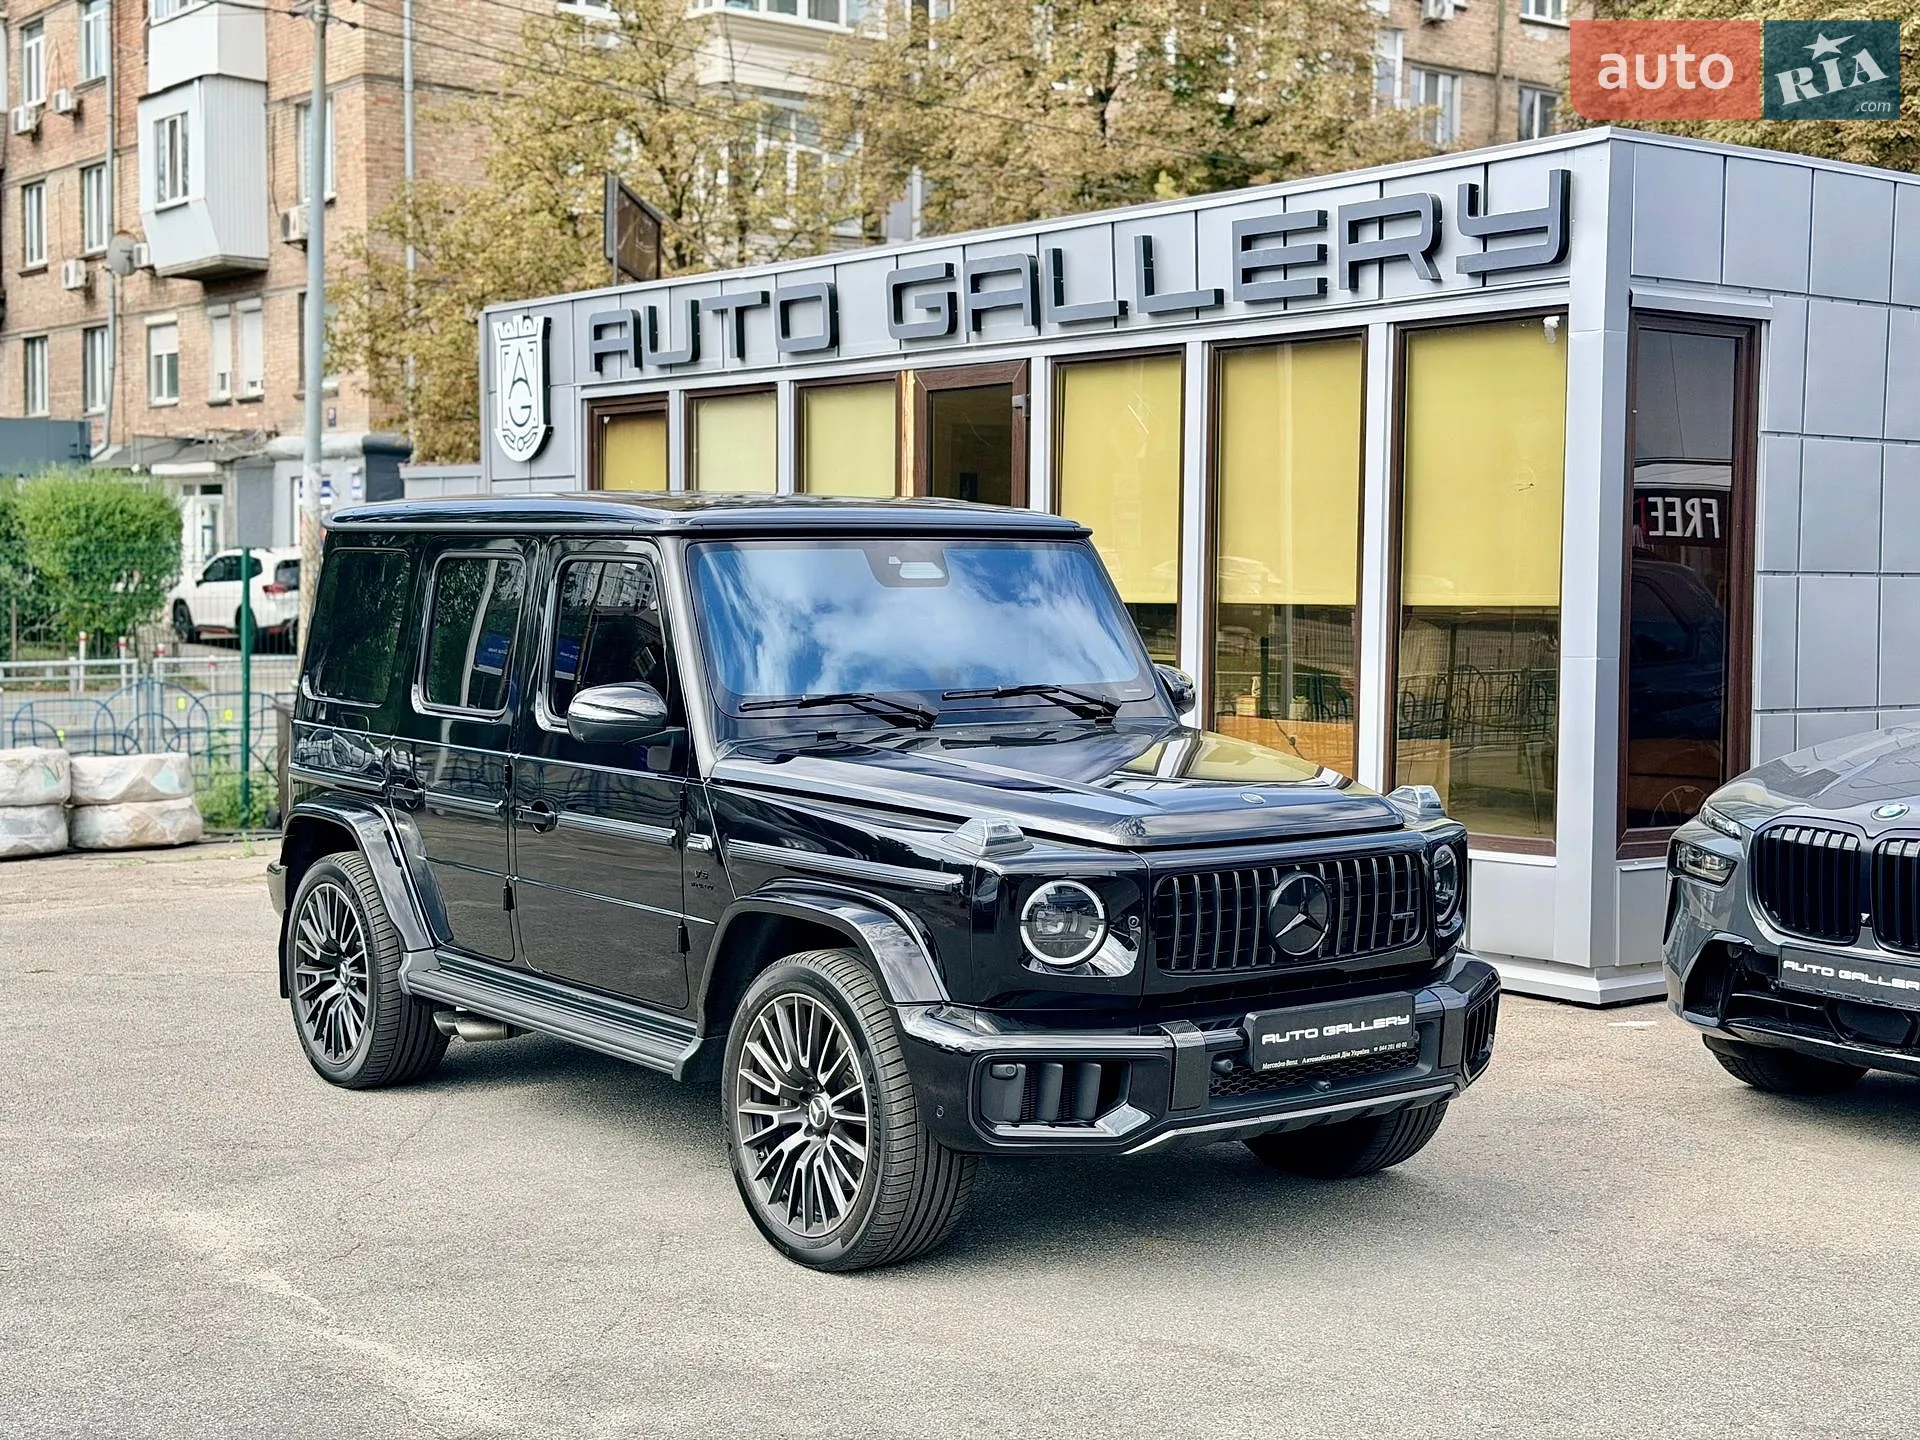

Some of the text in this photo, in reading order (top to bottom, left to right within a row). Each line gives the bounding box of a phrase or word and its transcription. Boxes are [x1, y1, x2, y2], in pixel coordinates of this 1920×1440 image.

[588, 168, 1572, 372] AUTO GALLERY
[1783, 960, 1835, 977] AUTO
[1262, 1015, 1409, 1044] AUTO GALLERY
